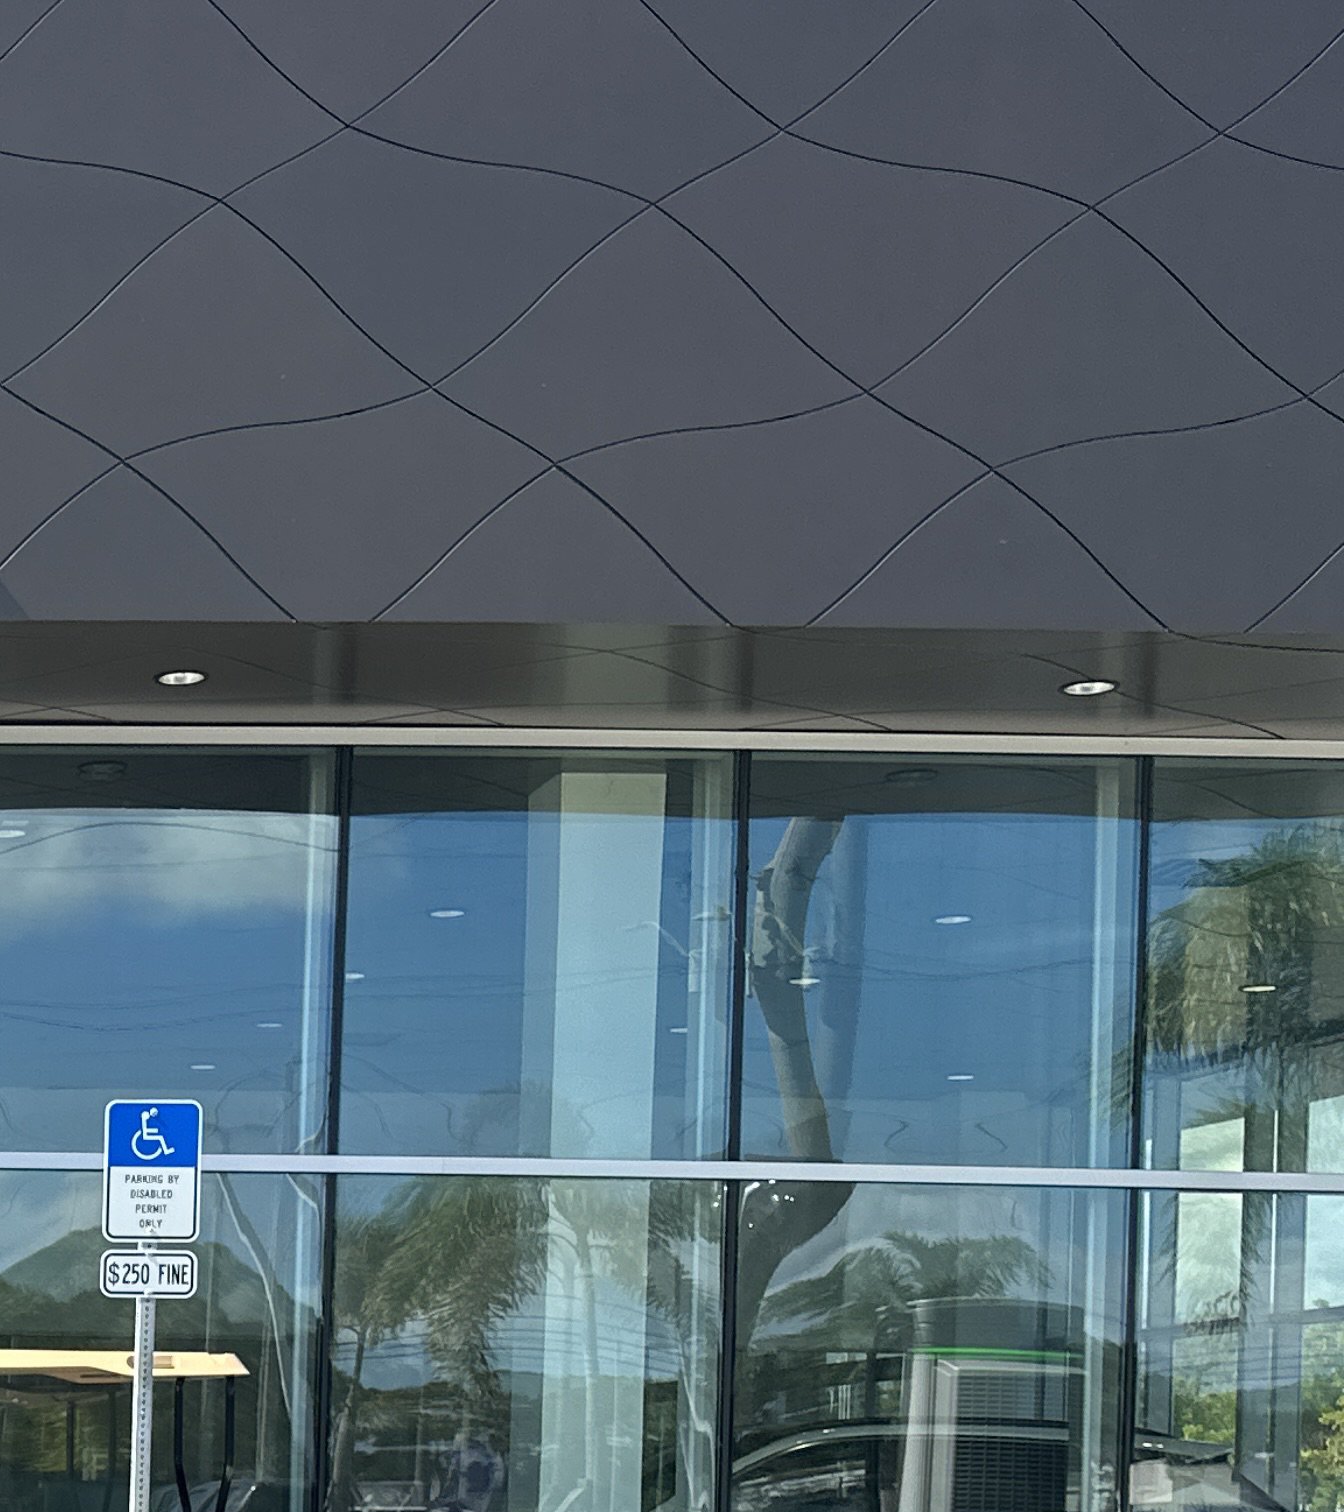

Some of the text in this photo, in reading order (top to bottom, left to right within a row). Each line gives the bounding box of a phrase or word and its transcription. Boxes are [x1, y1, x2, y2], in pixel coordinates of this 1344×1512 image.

[124, 1174, 180, 1185] PARKING BY
[130, 1189, 173, 1199] DISABLED
[135, 1204, 167, 1214] PERMIT
[139, 1219, 163, 1229] ONLY
[108, 1261, 189, 1287] $250 FINE
